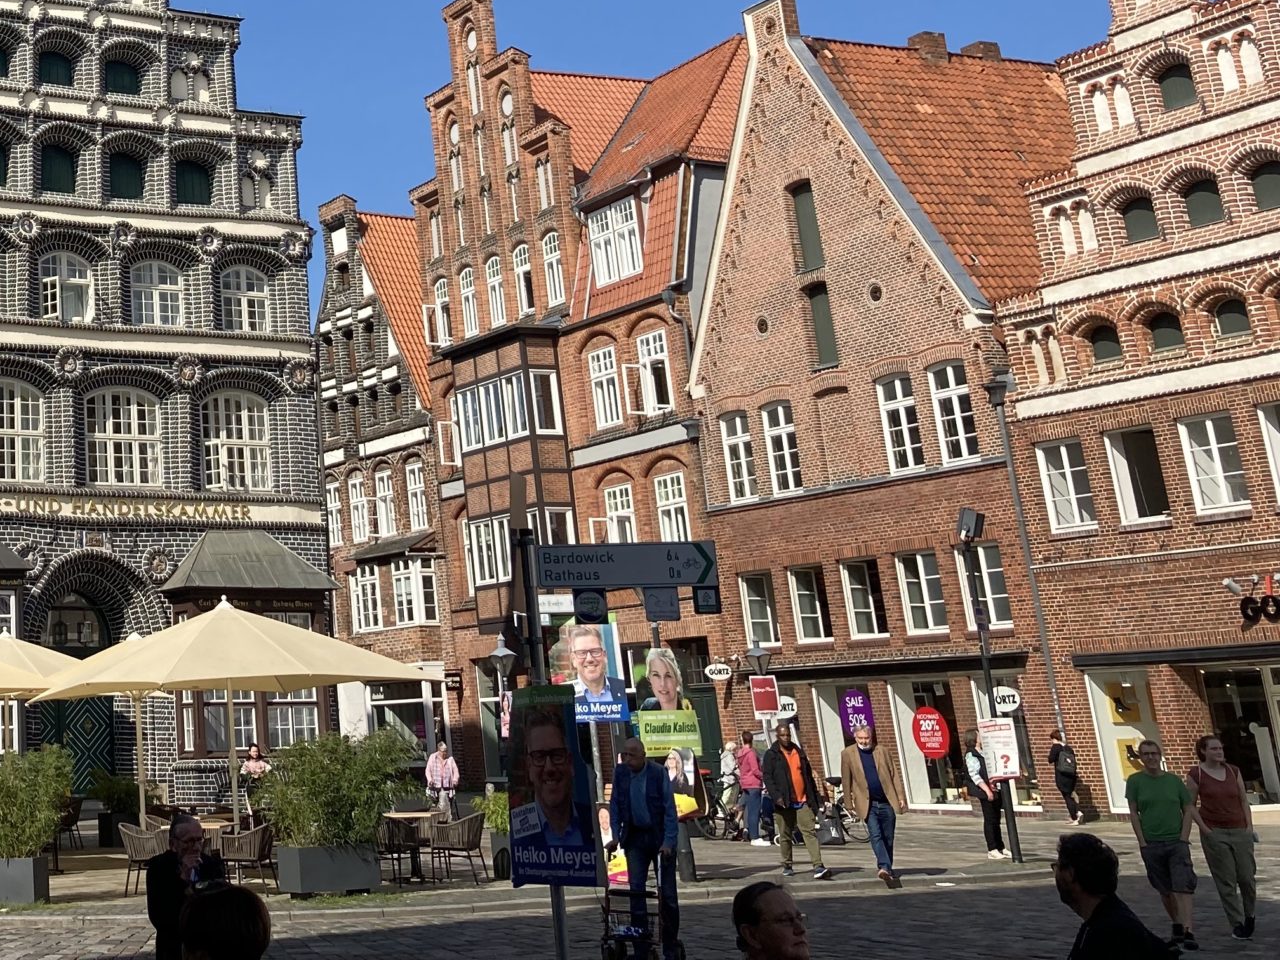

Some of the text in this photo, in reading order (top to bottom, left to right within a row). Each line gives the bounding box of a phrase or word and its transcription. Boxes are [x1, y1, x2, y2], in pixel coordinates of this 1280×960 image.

[72, 497, 252, 521] HANDELSKAMMER
[543, 551, 615, 564] Bardowick
[544, 569, 600, 581] Rathaus
[590, 702, 622, 714] Meyer
[845, 696, 864, 707] SALE
[849, 713, 867, 726] 50%
[919, 720, 940, 731] 20%
[644, 721, 697, 734] Claudia Kalisch
[514, 846, 547, 864] Heiko
[550, 847, 597, 869] Meyer
